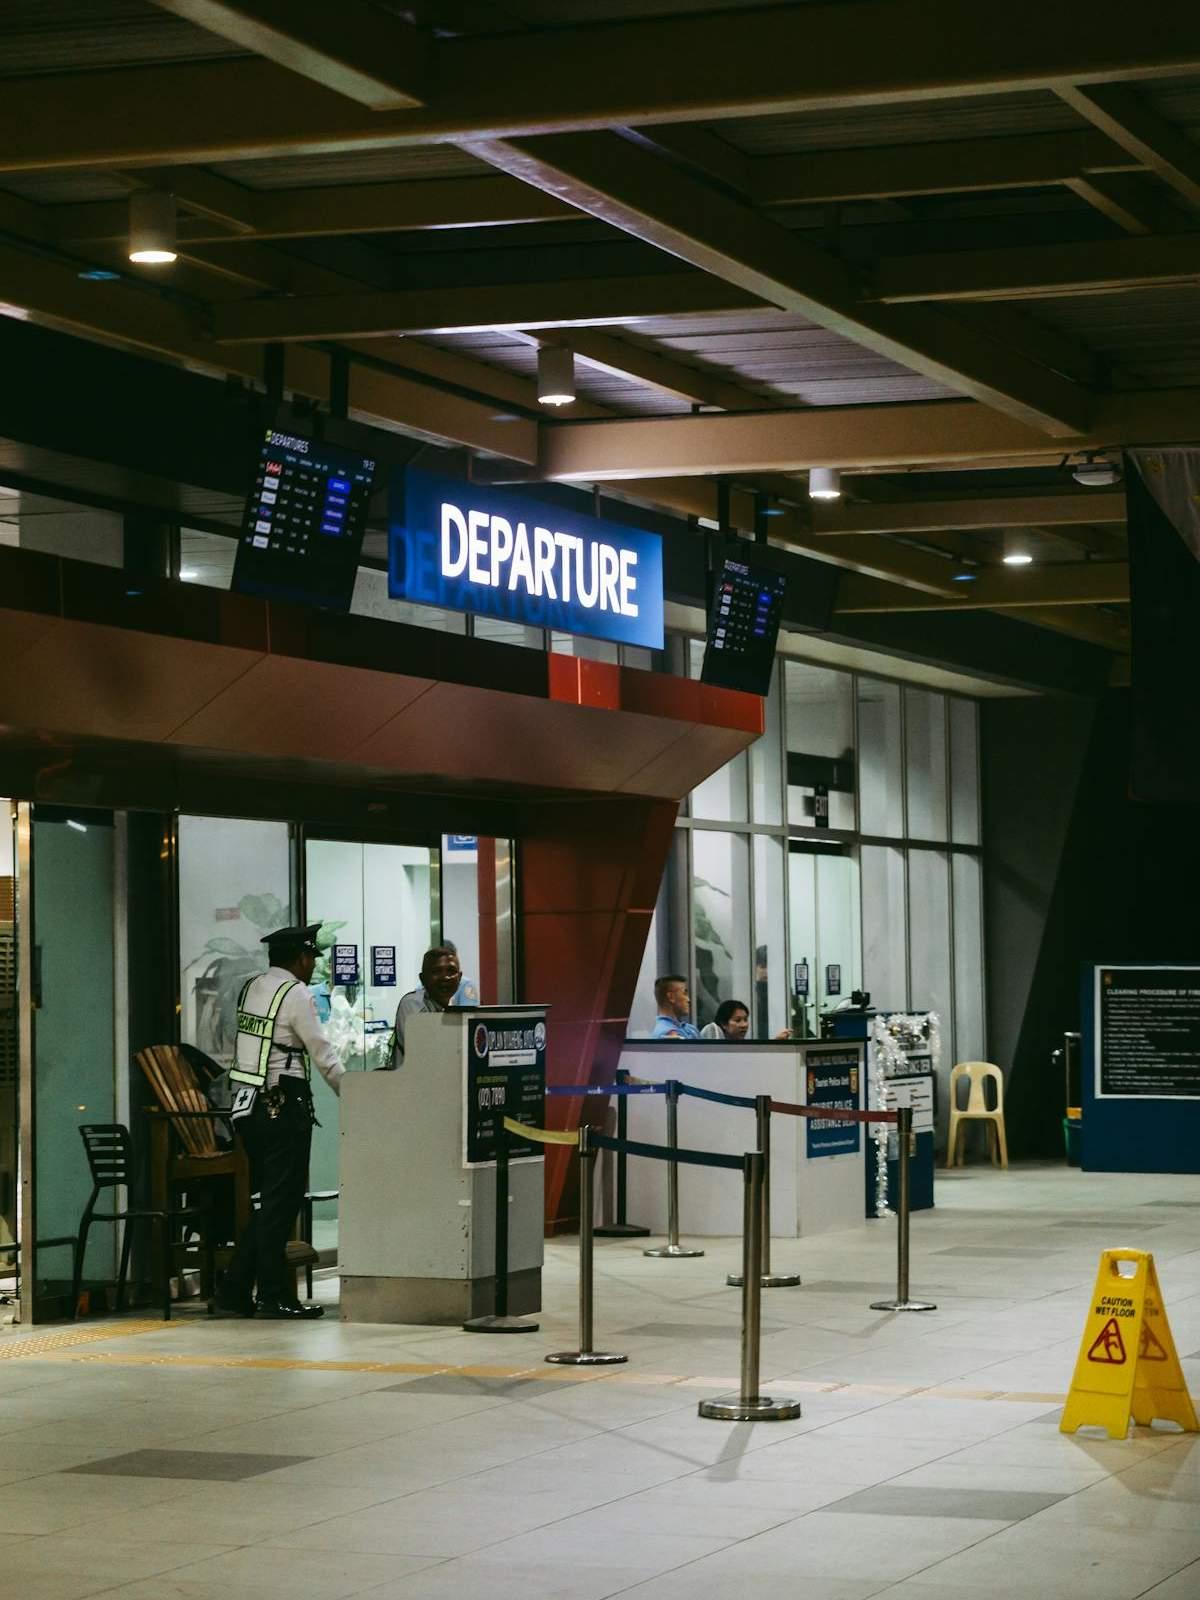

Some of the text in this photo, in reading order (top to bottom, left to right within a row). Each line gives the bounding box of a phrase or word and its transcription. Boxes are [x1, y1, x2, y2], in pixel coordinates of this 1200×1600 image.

[271, 432, 309, 453] DEPARTURES
[441, 502, 638, 617] DEPARTURE
[816, 795, 828, 817] EXIT
[815, 1078, 828, 1088] Tourist
[828, 1077, 840, 1087] Police
[1101, 1296, 1133, 1306] CAUTION
[1095, 1306, 1136, 1318] WET FLOOR
